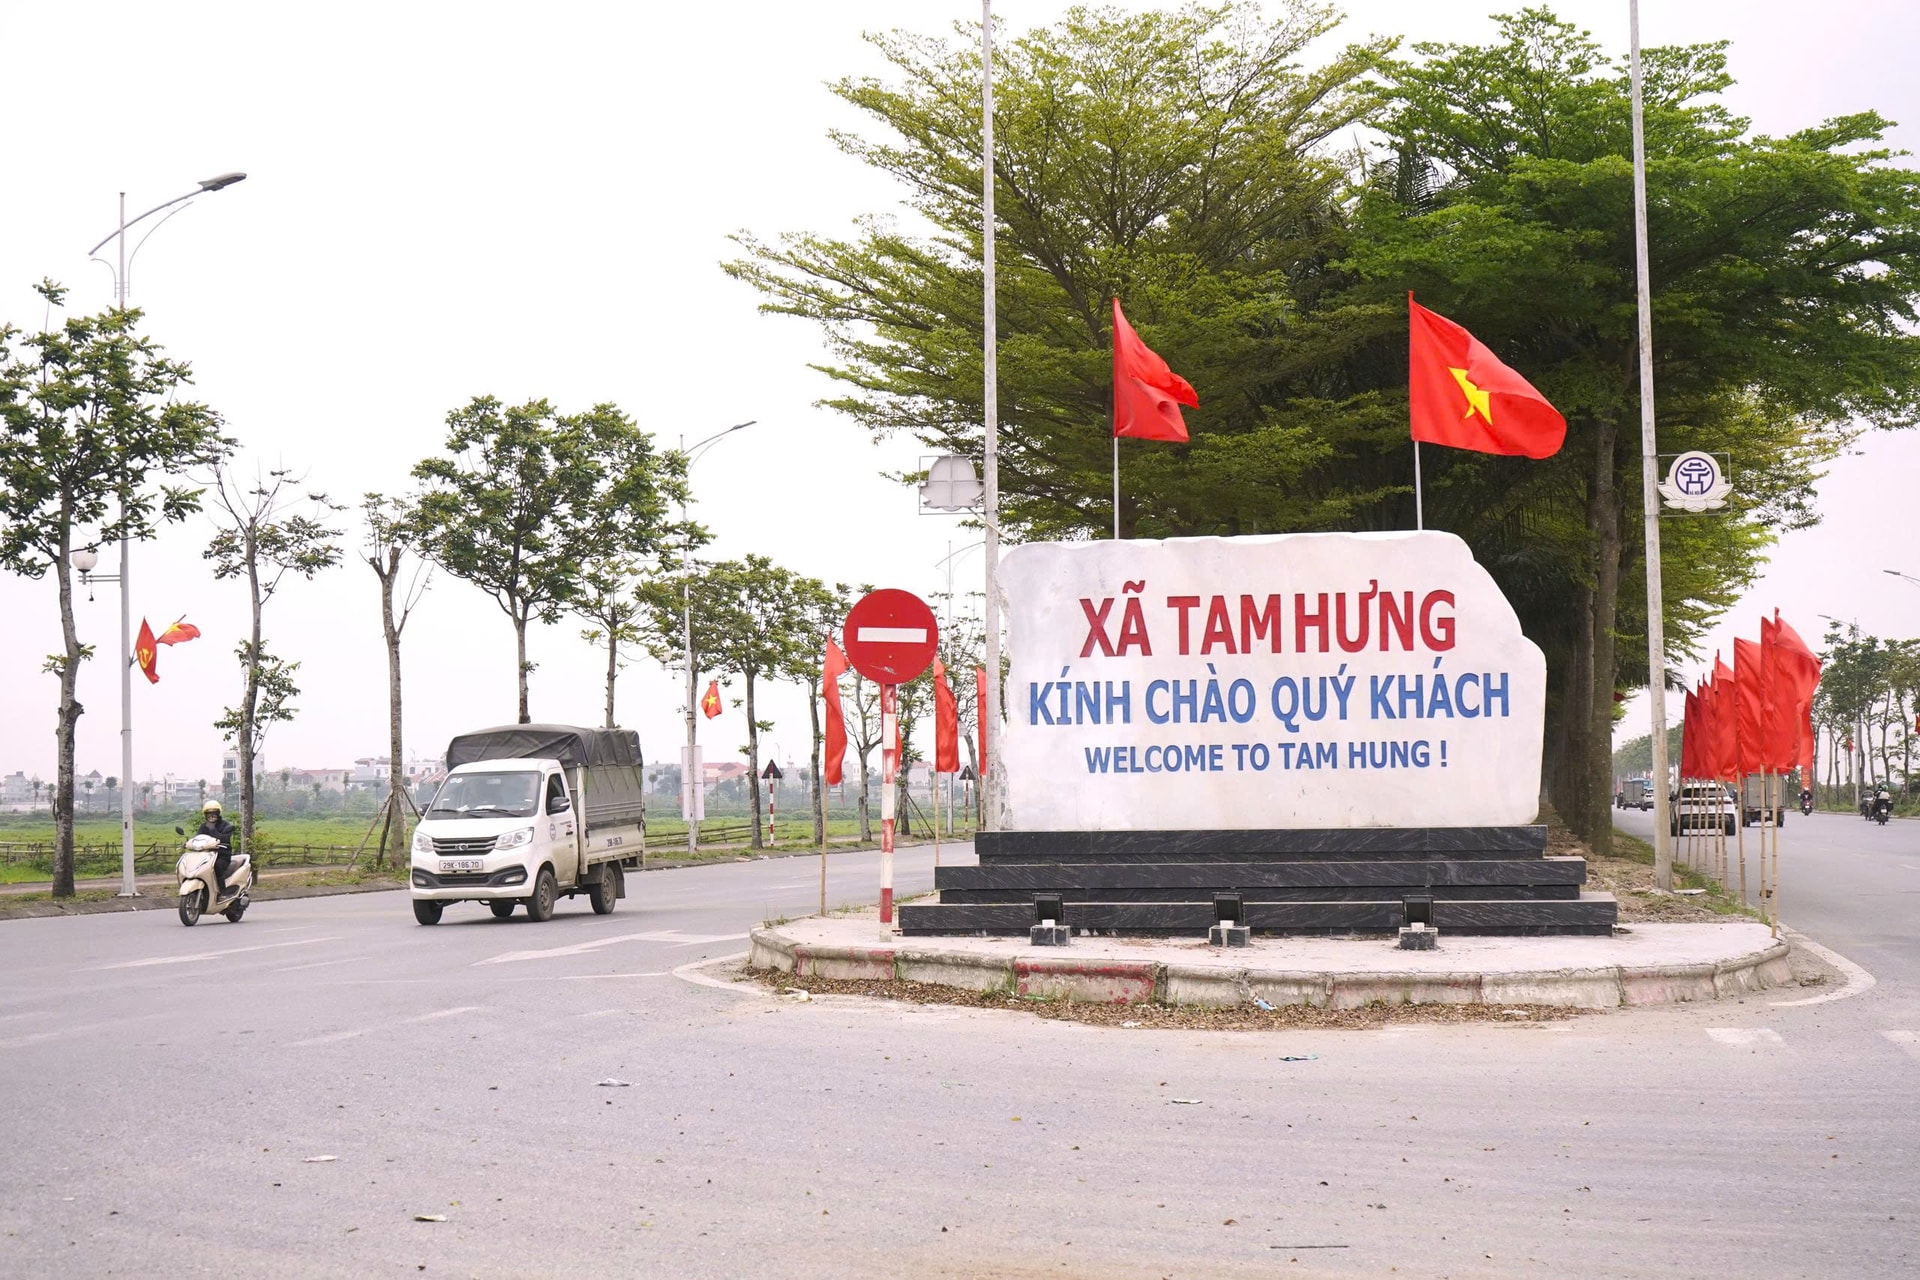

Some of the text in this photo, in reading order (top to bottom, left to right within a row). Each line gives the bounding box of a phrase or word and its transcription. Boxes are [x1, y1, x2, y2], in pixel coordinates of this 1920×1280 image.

[1080, 579, 1456, 657] XÃ TAM HƯNG
[1029, 656, 1510, 733] KÍNH CHÀO QUÝ KHÁCH
[1085, 745, 1223, 773] WELCOME
[1232, 743, 1270, 771] TO
[1278, 741, 1338, 770] TAM
[1348, 740, 1430, 769] HUNG
